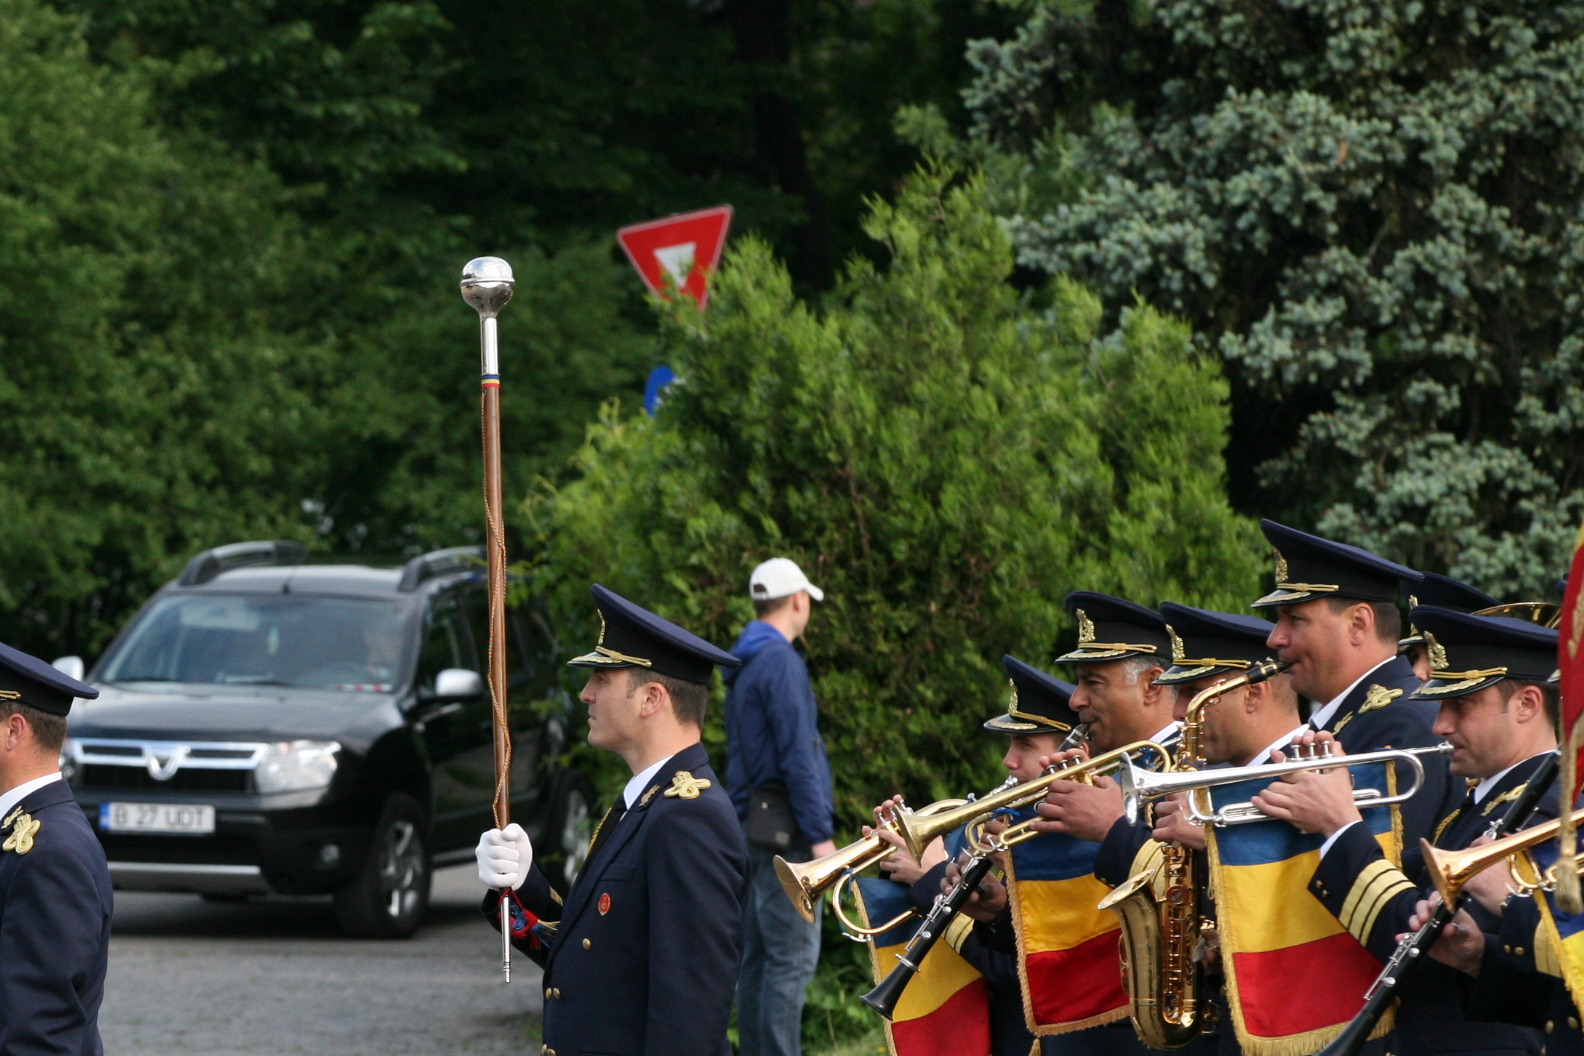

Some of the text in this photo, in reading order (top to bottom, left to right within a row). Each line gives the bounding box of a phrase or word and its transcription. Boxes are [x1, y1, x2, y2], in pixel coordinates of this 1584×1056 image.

[114, 804, 205, 827] B 27 UDT
